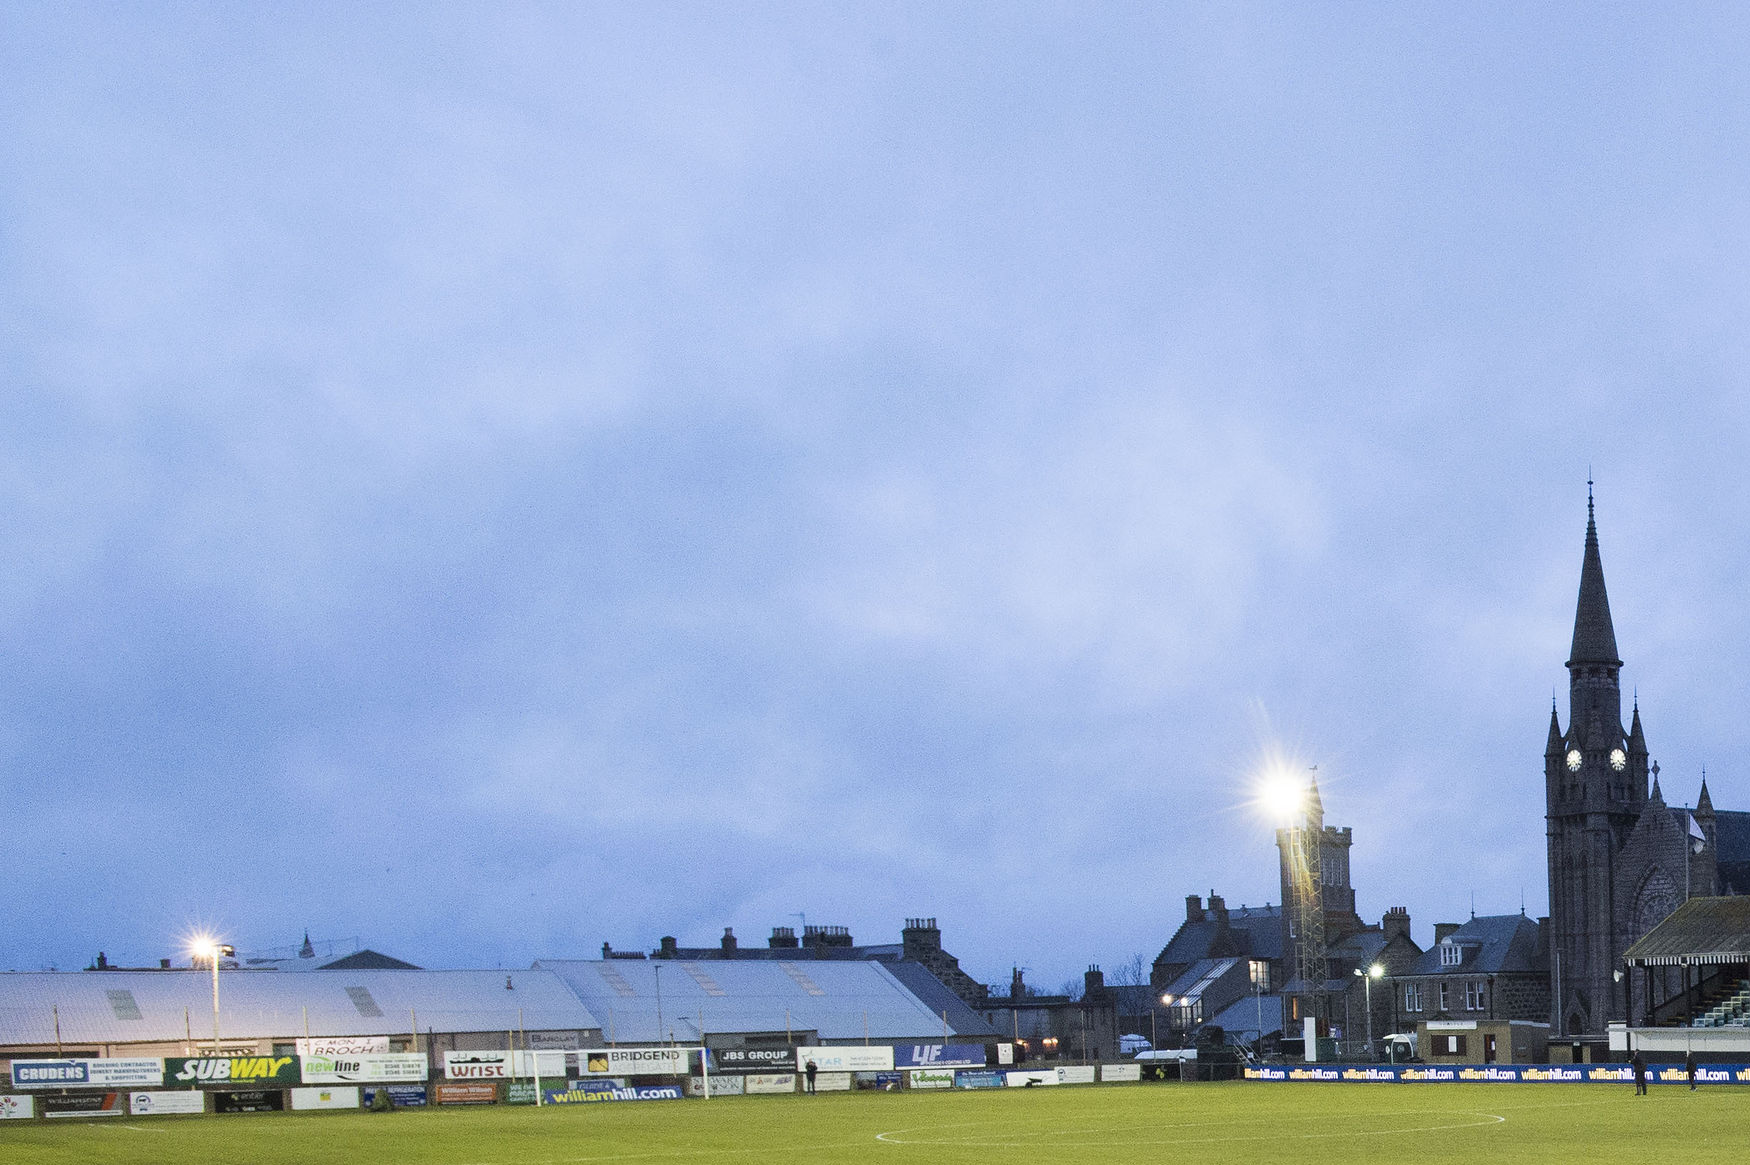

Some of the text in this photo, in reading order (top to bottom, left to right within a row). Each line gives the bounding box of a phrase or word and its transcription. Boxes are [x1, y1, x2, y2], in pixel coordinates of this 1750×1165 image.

[314, 1045, 374, 1055] BROCH
[611, 1051, 680, 1061] BRIDGEND
[723, 1051, 788, 1060] JBS GROUP
[175, 1056, 293, 1081] SUBWAY
[305, 1060, 360, 1073] newline
[451, 1065, 504, 1077] wrist
[19, 1067, 84, 1080] CRUDENS
[1289, 1068, 1339, 1079] williamhill.com
[1342, 1068, 1395, 1079] williamhill.com
[1400, 1068, 1455, 1080] williamhill.com
[1458, 1068, 1516, 1080] williamhill.com
[1521, 1068, 1582, 1080] williamhill.com
[552, 1086, 678, 1104] williamhill.com
